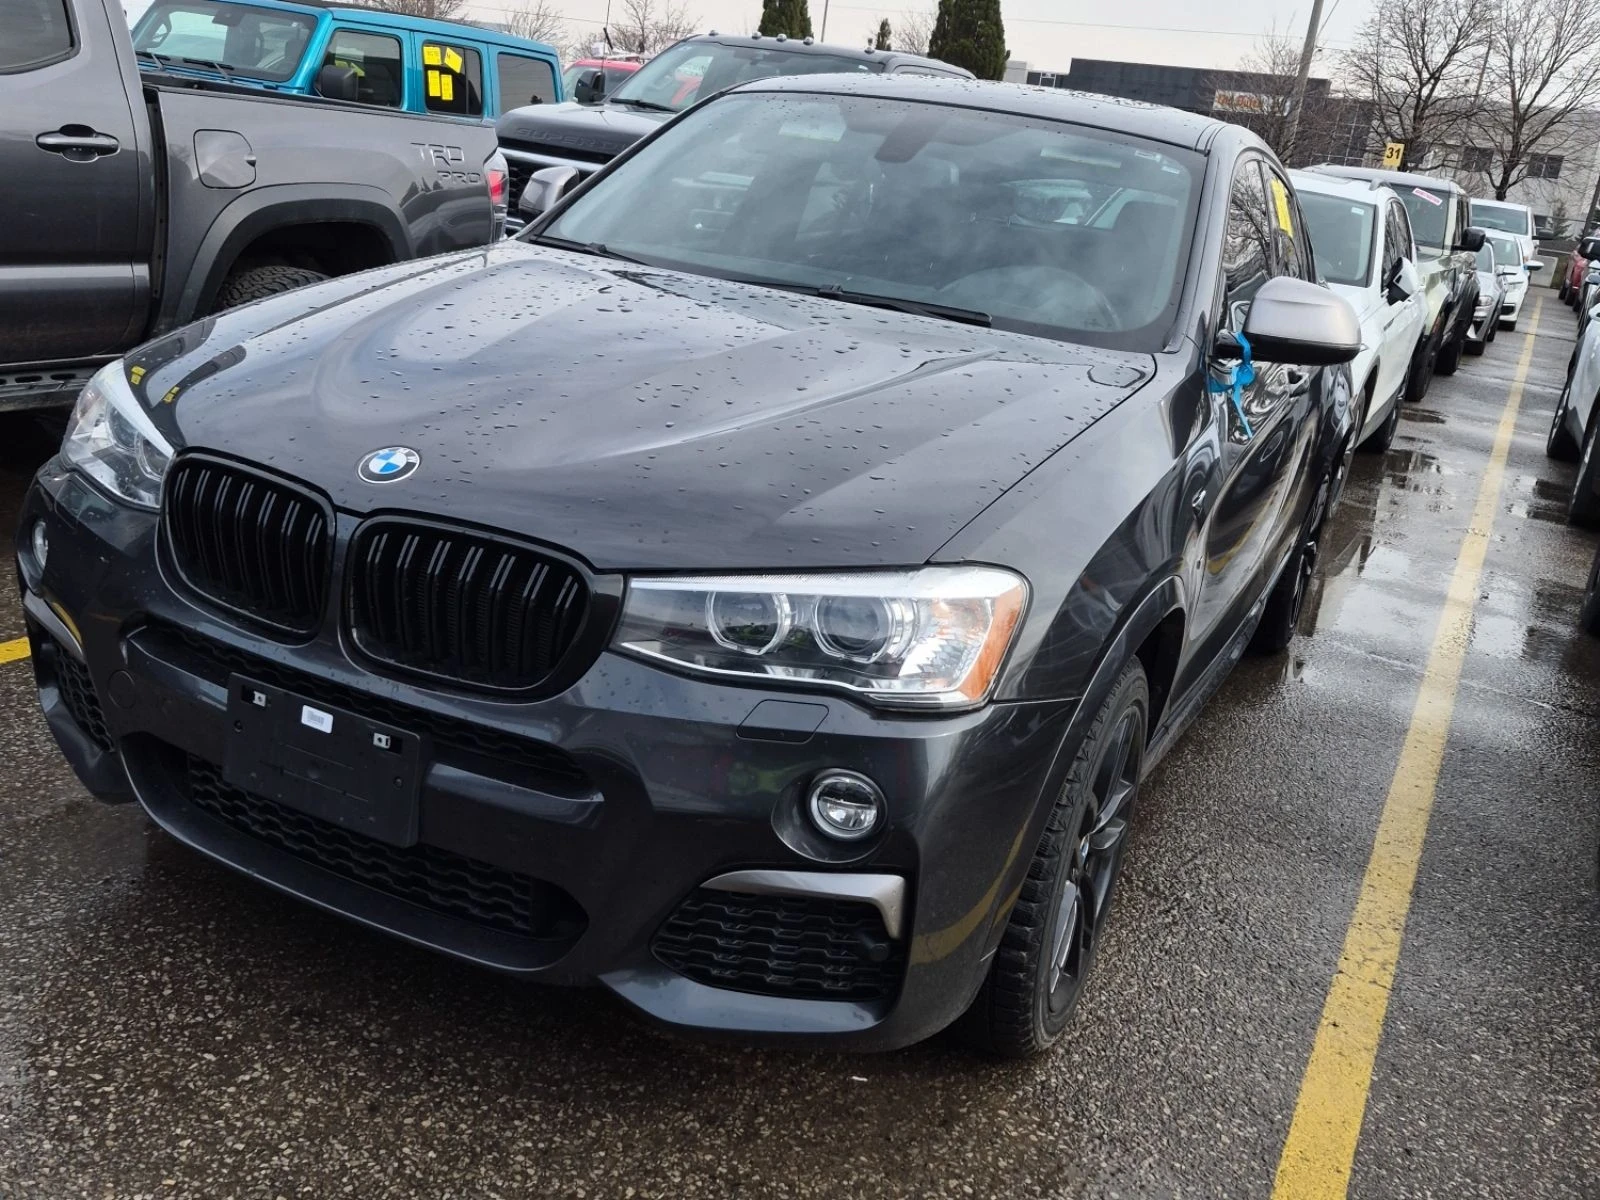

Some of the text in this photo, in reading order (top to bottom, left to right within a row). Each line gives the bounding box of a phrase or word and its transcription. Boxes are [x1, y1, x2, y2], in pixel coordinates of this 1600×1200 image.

[515, 127, 597, 147] SUPER
[410, 142, 465, 167] TRD
[1386, 147, 1402, 160] 31
[436, 170, 481, 185] PRO
